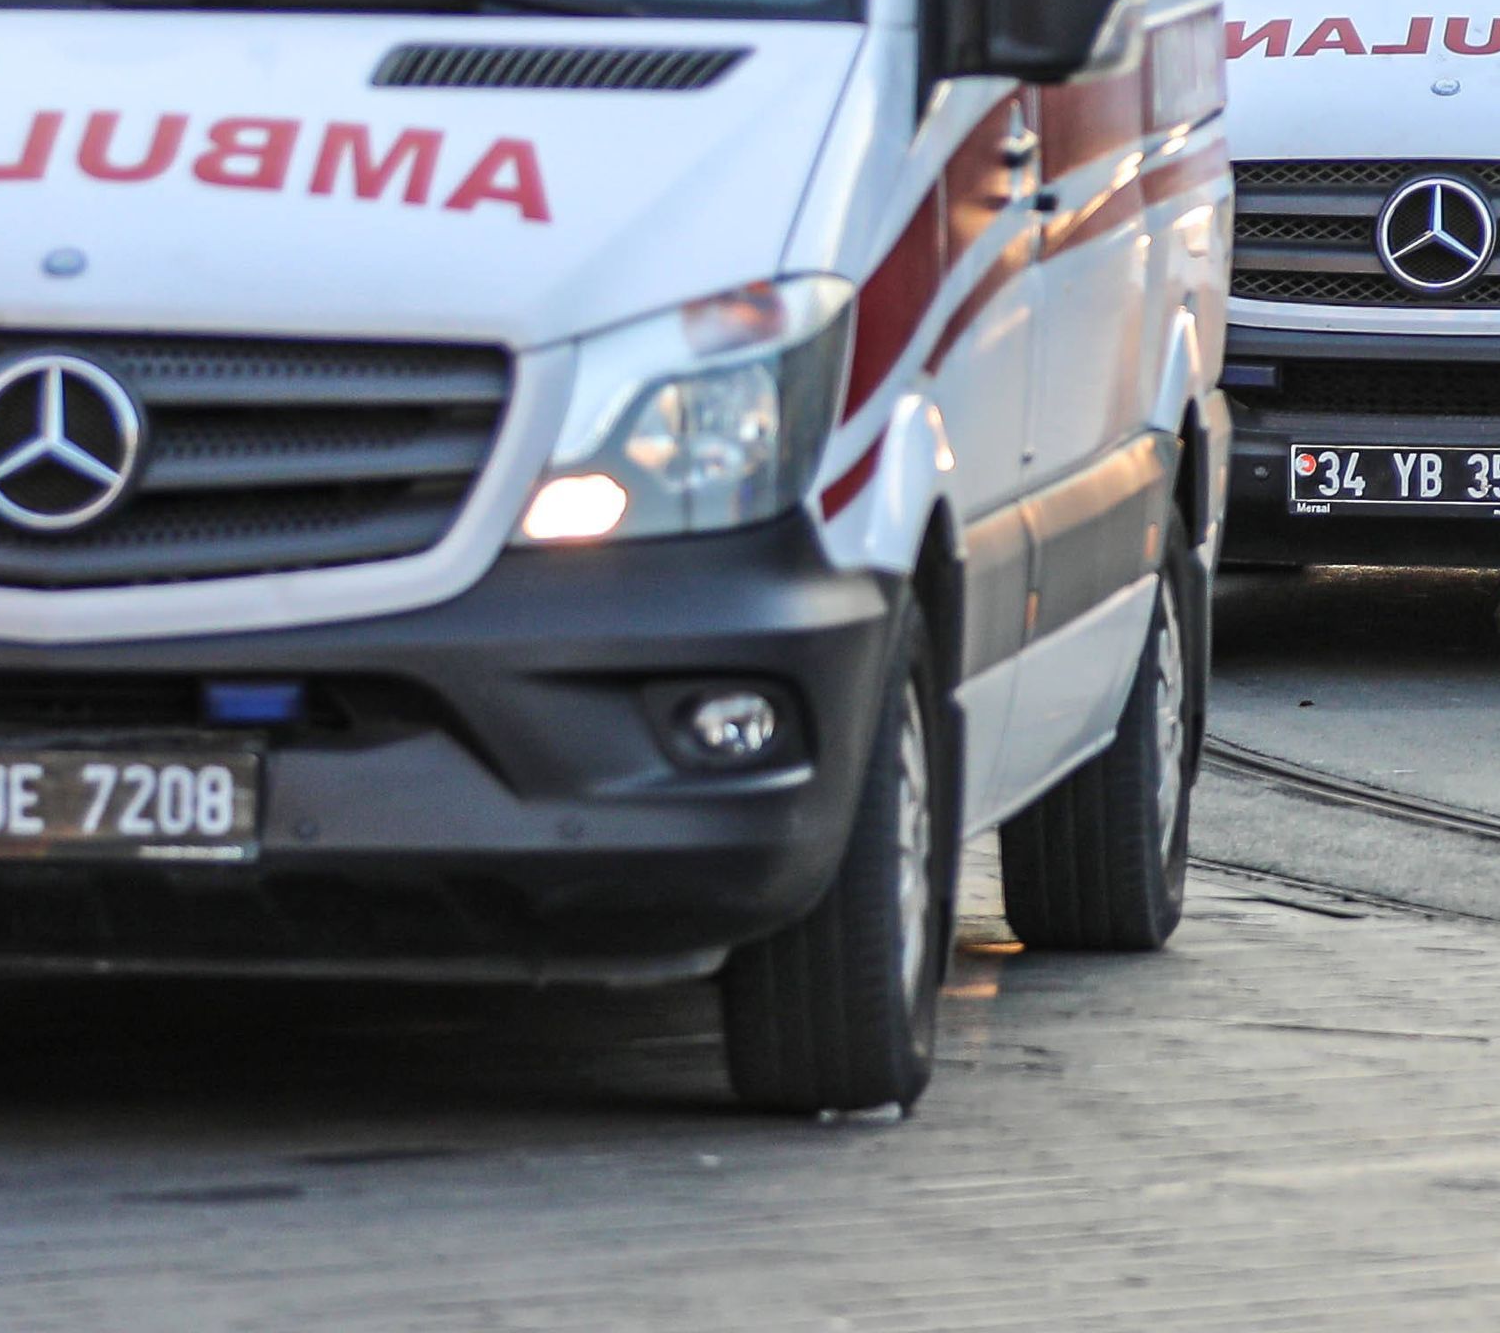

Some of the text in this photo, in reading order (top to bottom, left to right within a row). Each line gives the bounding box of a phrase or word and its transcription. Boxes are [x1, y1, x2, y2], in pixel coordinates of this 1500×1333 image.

[1318, 451, 1366, 497] 34
[1393, 452, 1443, 498] YB
[81, 764, 235, 835] 7208
